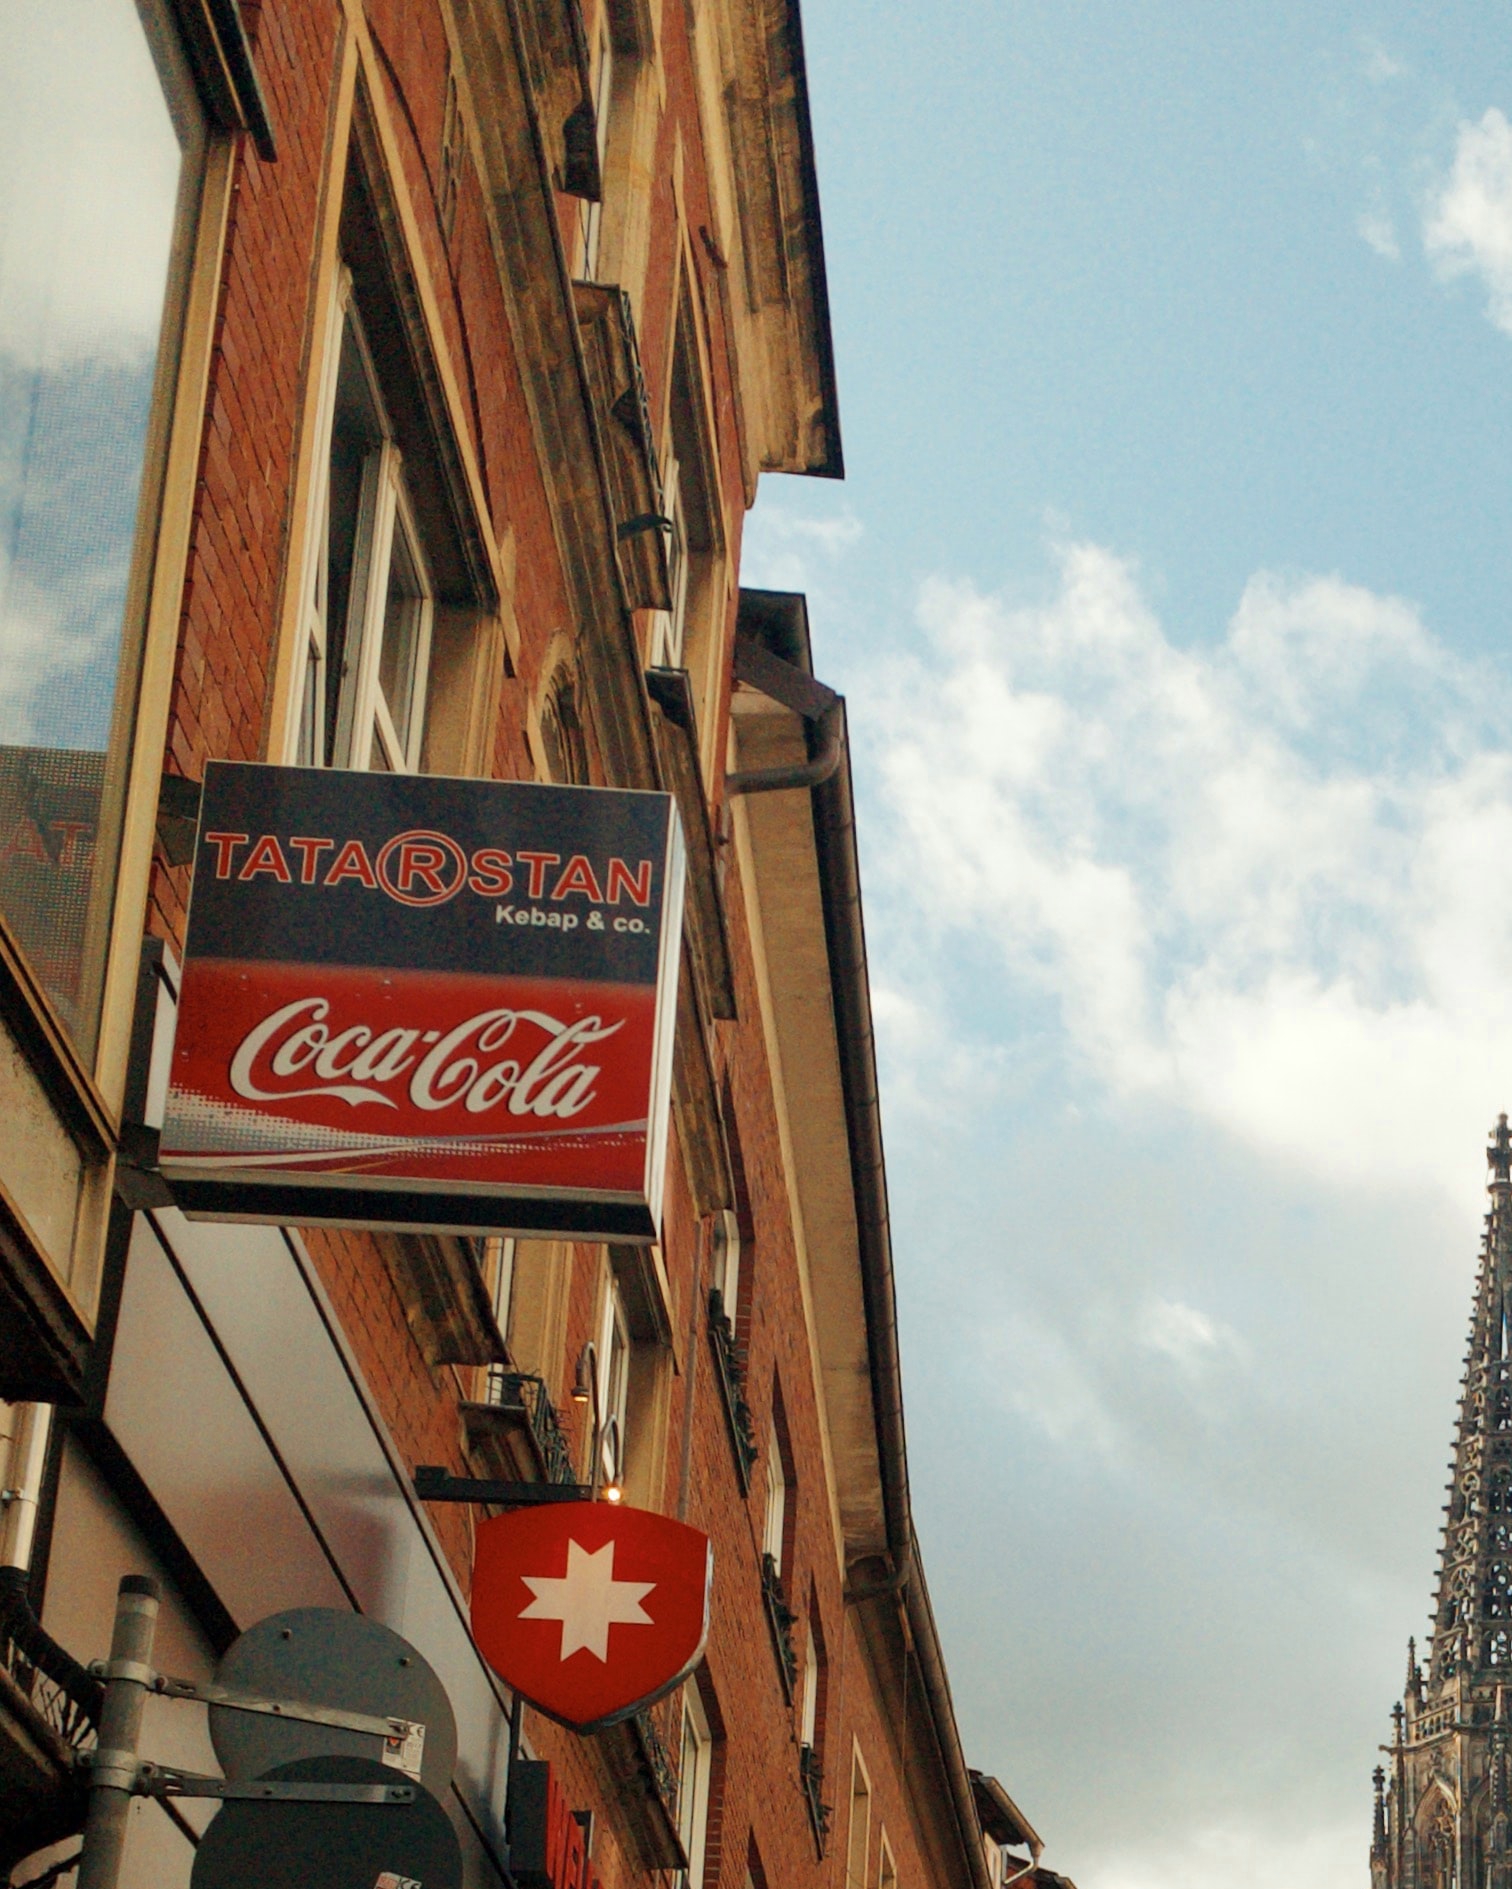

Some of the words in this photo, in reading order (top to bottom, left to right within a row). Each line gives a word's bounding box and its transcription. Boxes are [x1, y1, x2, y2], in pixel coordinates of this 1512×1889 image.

[495, 904, 579, 932] Kebap
[586, 910, 606, 931] &
[613, 914, 651, 935] co.
